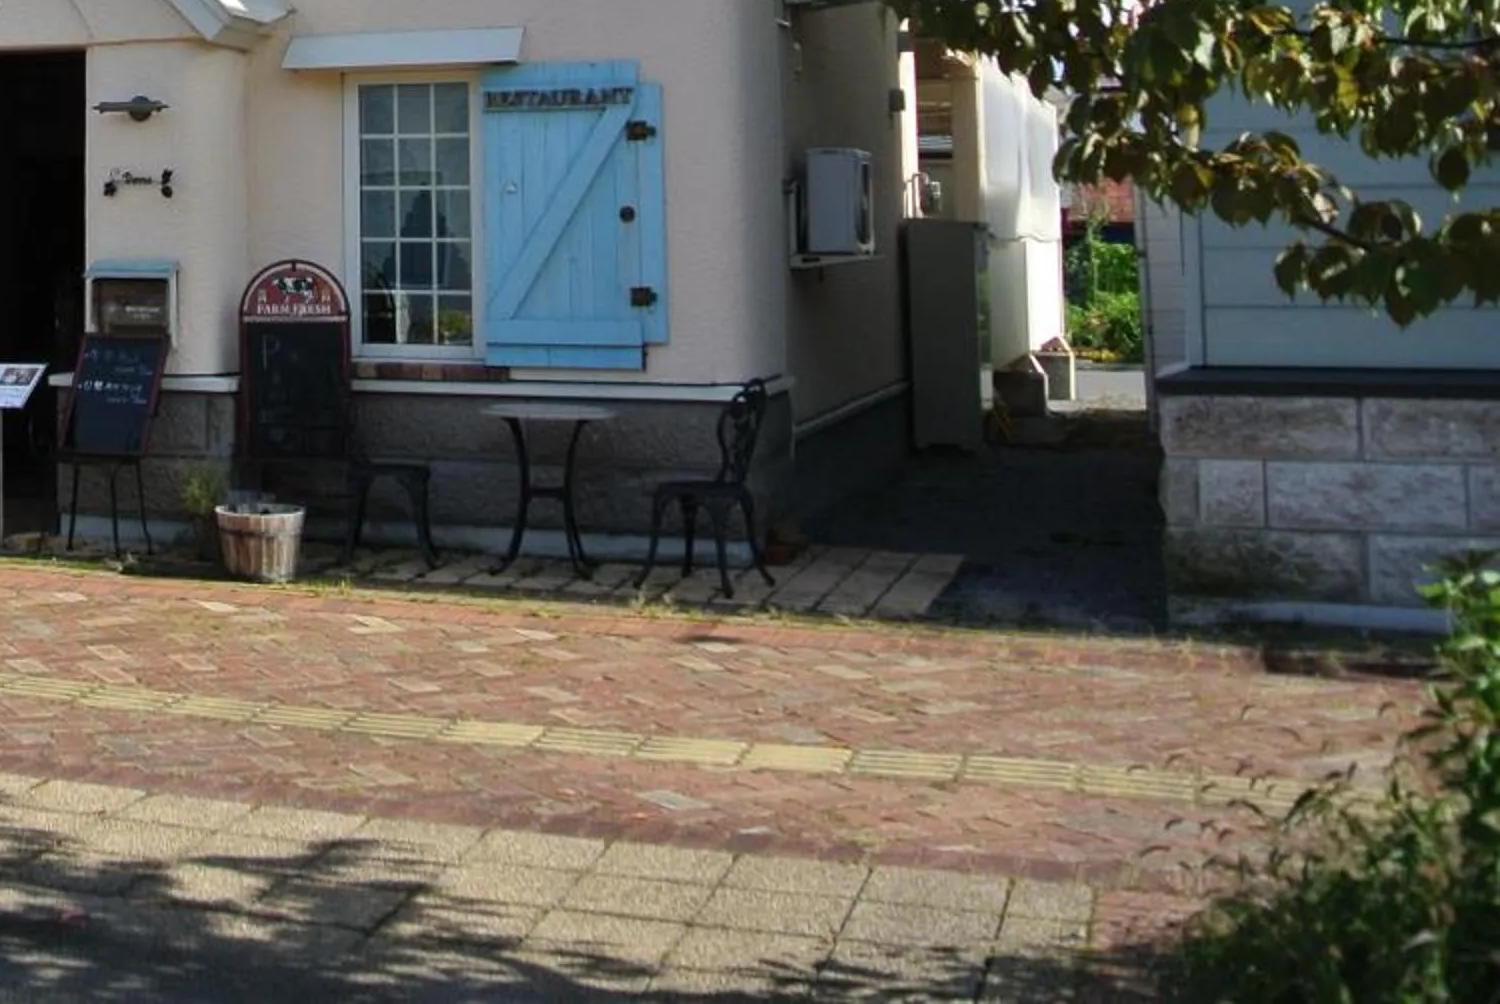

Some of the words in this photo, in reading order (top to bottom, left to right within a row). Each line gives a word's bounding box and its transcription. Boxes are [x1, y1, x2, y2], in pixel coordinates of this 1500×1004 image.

[484, 87, 634, 108] RESTAURANT
[257, 303, 290, 315] FARM
[292, 303, 332, 316] FRESH
